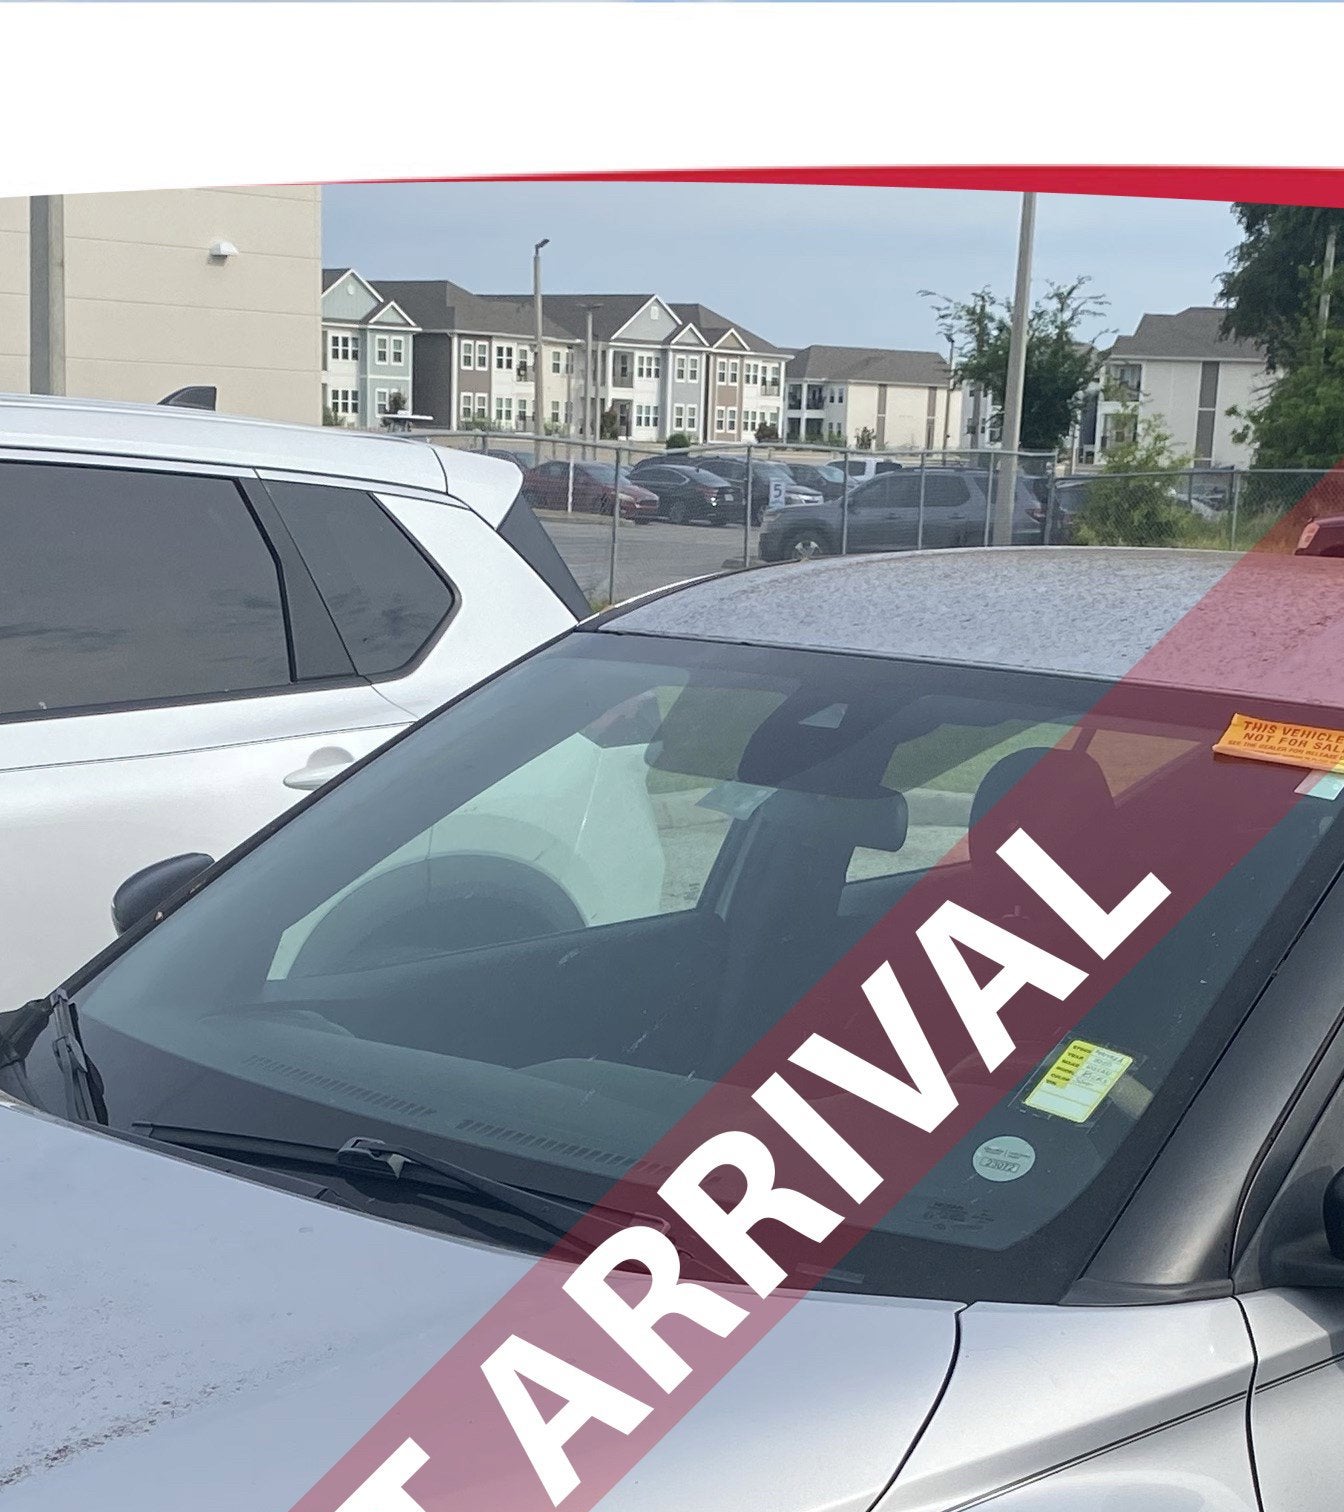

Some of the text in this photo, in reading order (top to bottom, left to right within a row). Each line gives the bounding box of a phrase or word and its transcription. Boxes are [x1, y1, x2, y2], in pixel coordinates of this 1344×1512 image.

[773, 484, 782, 499] 5
[1243, 720, 1277, 734] THIS
[1243, 732, 1275, 743] NOT
[1279, 737, 1308, 749] FOR
